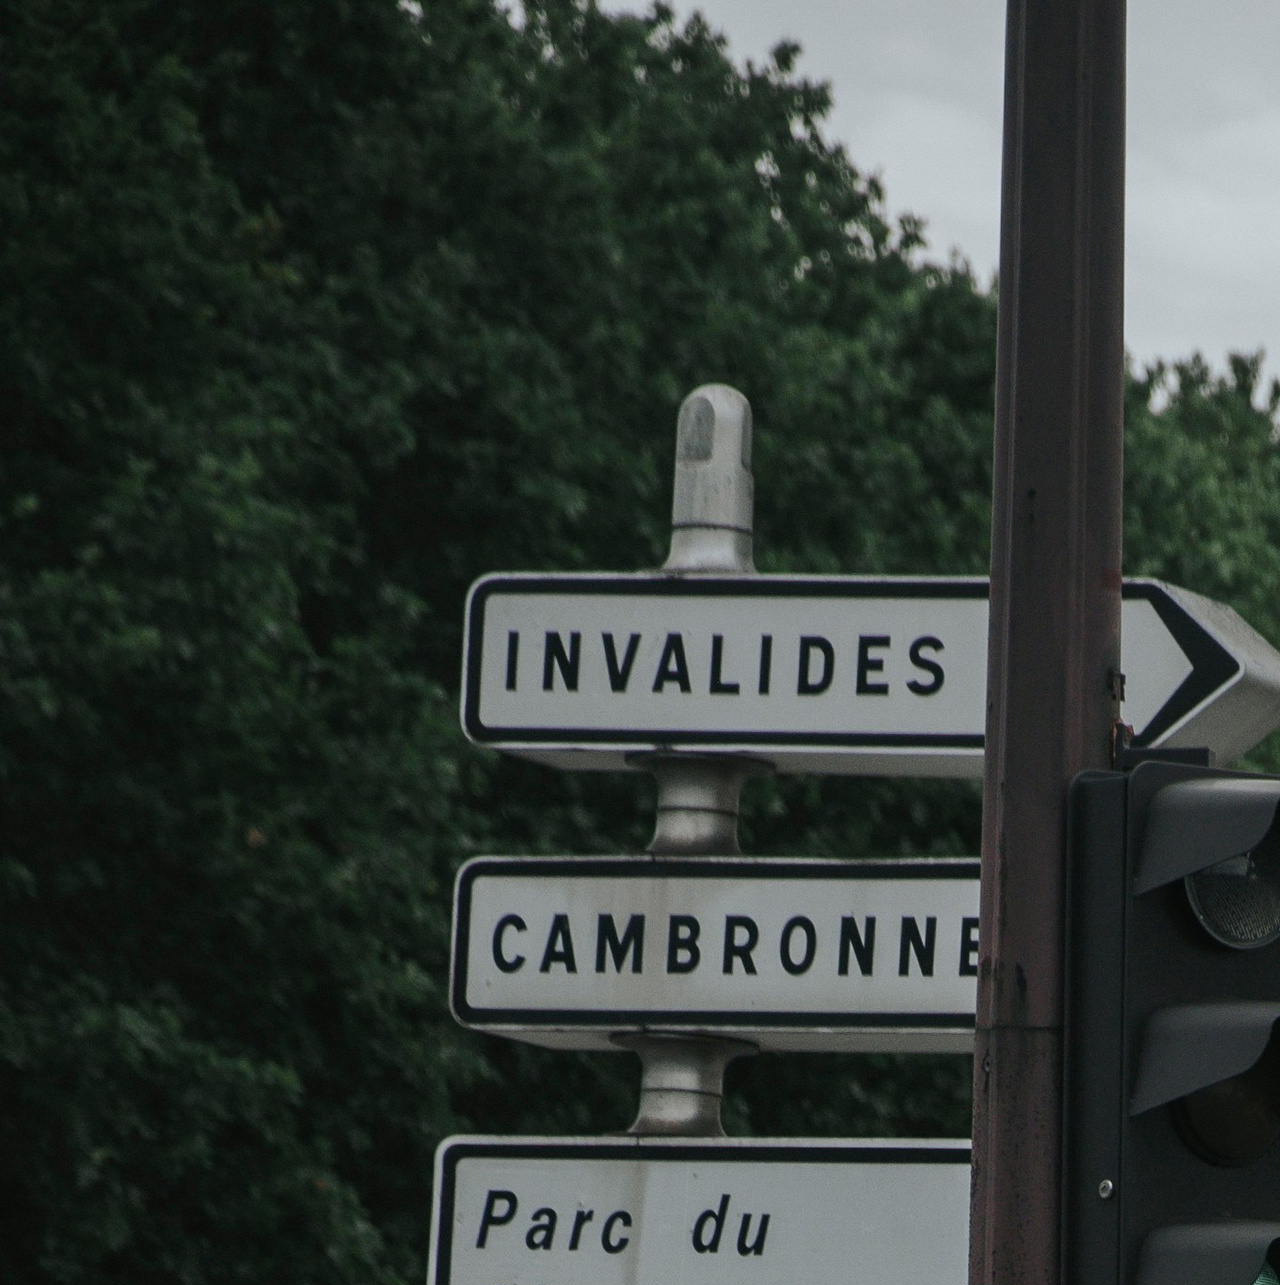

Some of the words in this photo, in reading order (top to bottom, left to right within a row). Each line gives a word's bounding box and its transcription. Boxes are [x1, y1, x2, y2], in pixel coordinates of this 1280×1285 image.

[506, 631, 945, 696] INVALIDES
[492, 913, 980, 977] CAMBRONNE
[476, 1190, 632, 1254] Parc
[692, 1194, 770, 1257] du
